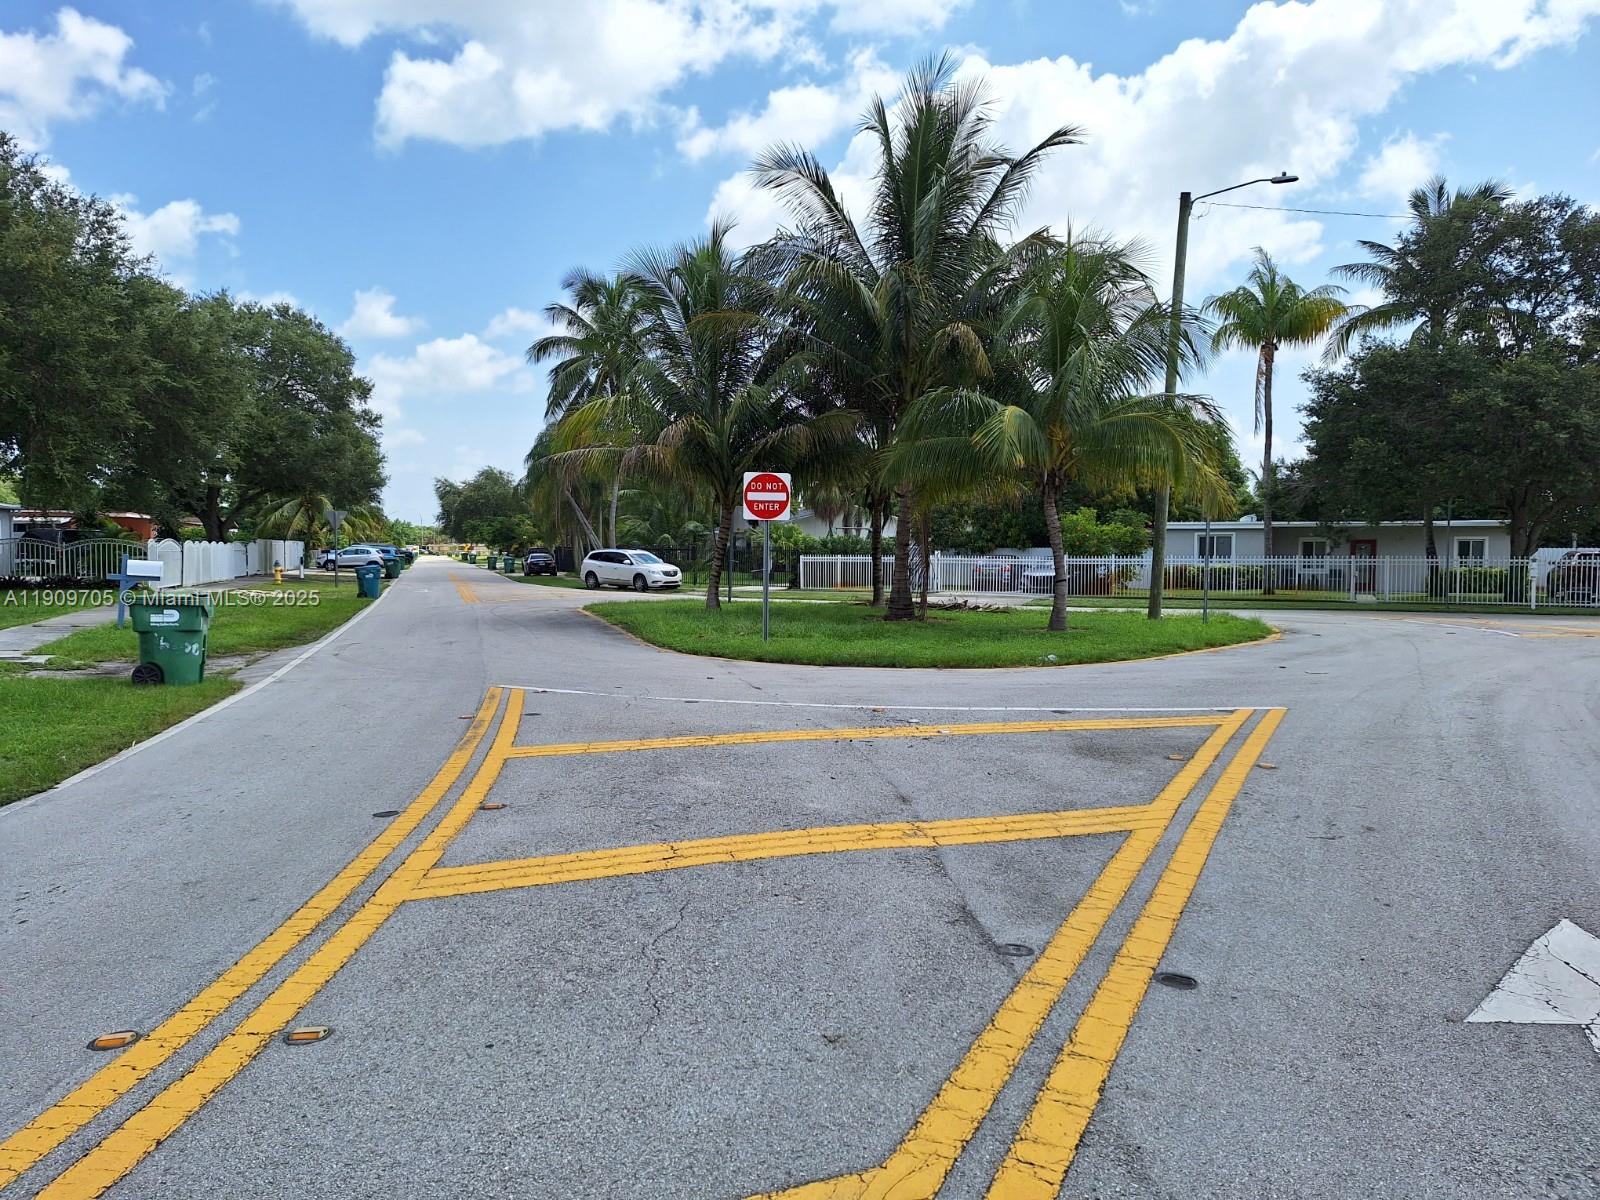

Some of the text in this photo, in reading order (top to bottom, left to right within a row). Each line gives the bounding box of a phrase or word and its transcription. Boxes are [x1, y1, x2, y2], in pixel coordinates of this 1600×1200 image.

[751, 482, 783, 490] DO NOT
[753, 503, 780, 511] ENTER
